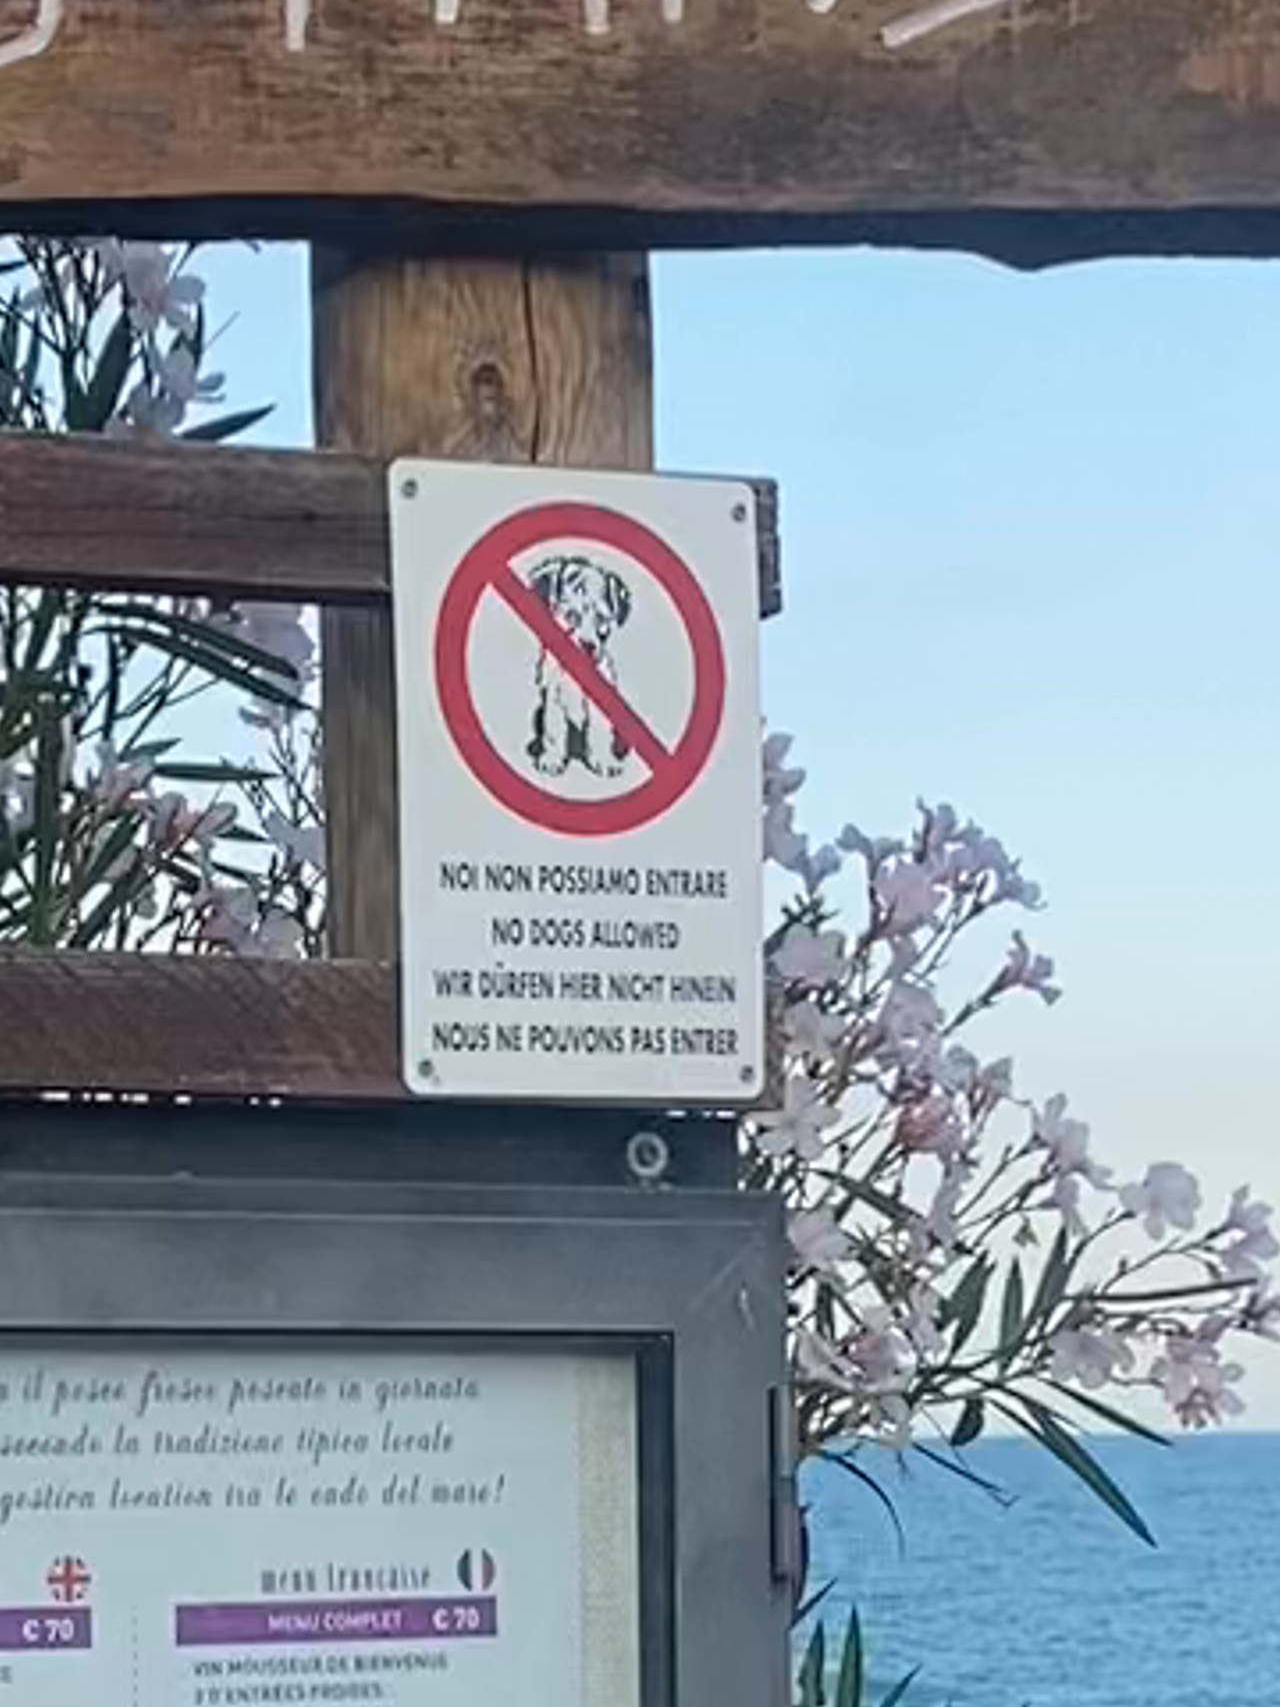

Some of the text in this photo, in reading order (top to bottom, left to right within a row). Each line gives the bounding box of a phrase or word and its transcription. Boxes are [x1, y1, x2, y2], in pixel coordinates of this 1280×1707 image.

[440, 863, 727, 898] NOI NON POSSIAMO ENTRARE
[492, 919, 679, 950] NO DOGS ALLOWED
[434, 962, 736, 1003] WIR DÜRFEN HIER NICHT HINEIN
[433, 1023, 738, 1057] NOUS NE POUVONS PAS ENTRER
[46, 1620, 74, 1641] 70
[454, 1607, 480, 1629] 70
